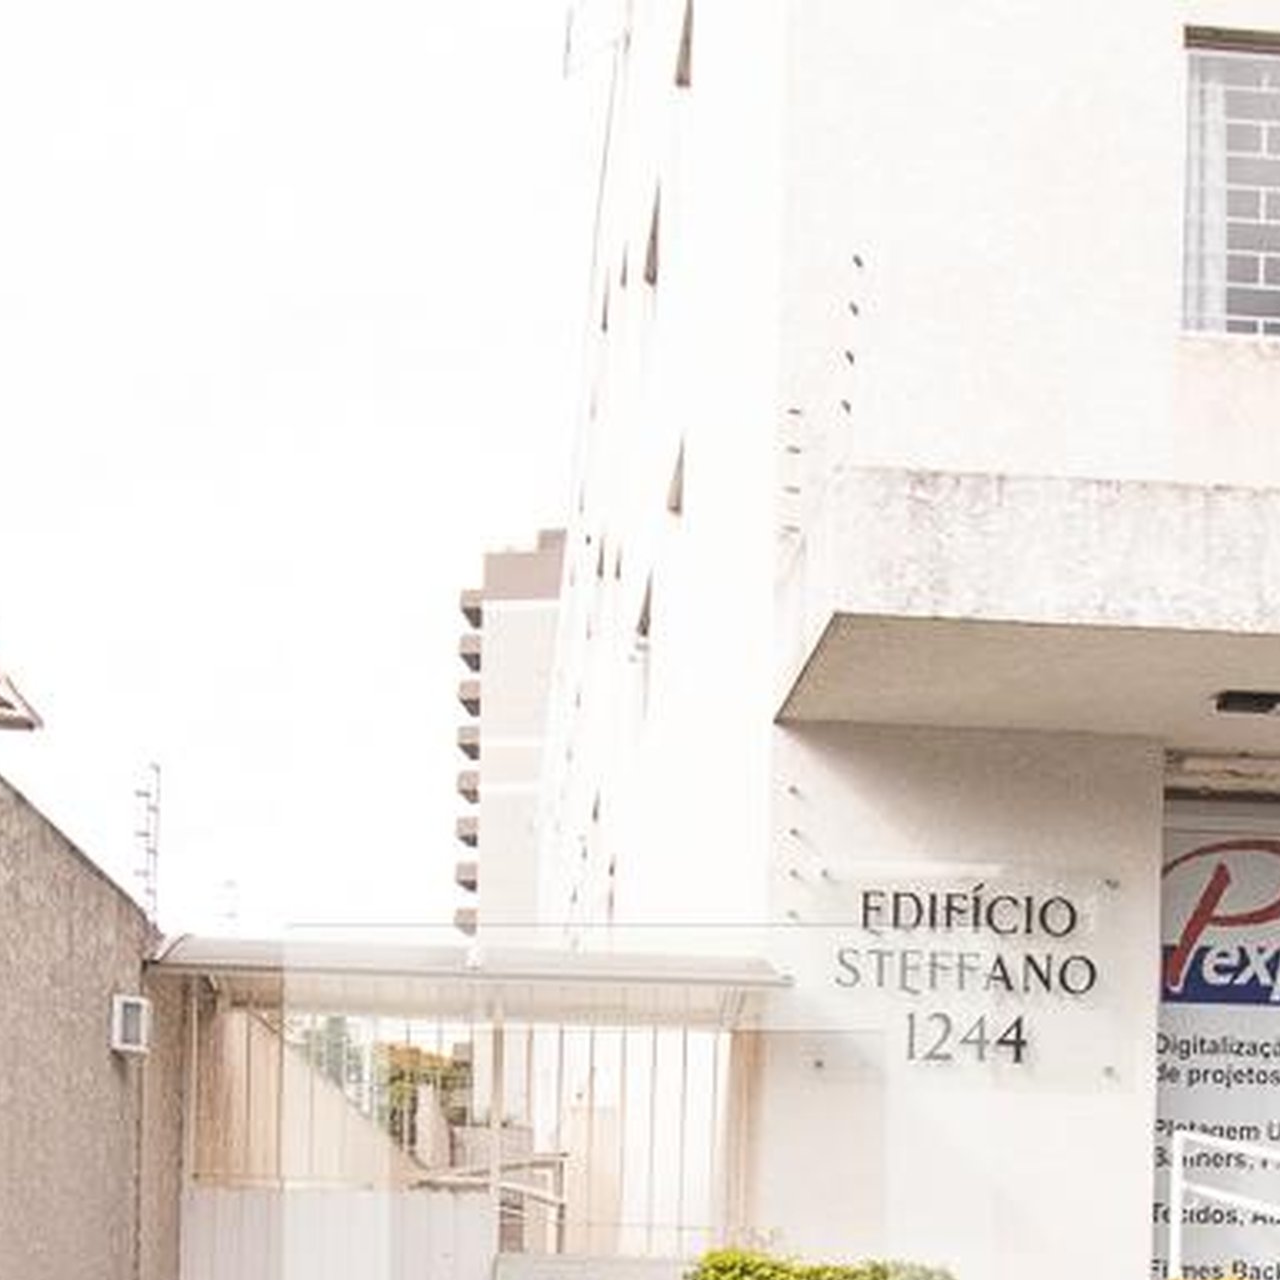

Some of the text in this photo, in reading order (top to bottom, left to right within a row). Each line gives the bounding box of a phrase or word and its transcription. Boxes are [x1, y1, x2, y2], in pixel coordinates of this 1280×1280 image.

[861, 882, 1078, 937] EDIFÍCIO
[835, 948, 1097, 995] STEFFANO
[906, 1012, 1027, 1063] 1244
